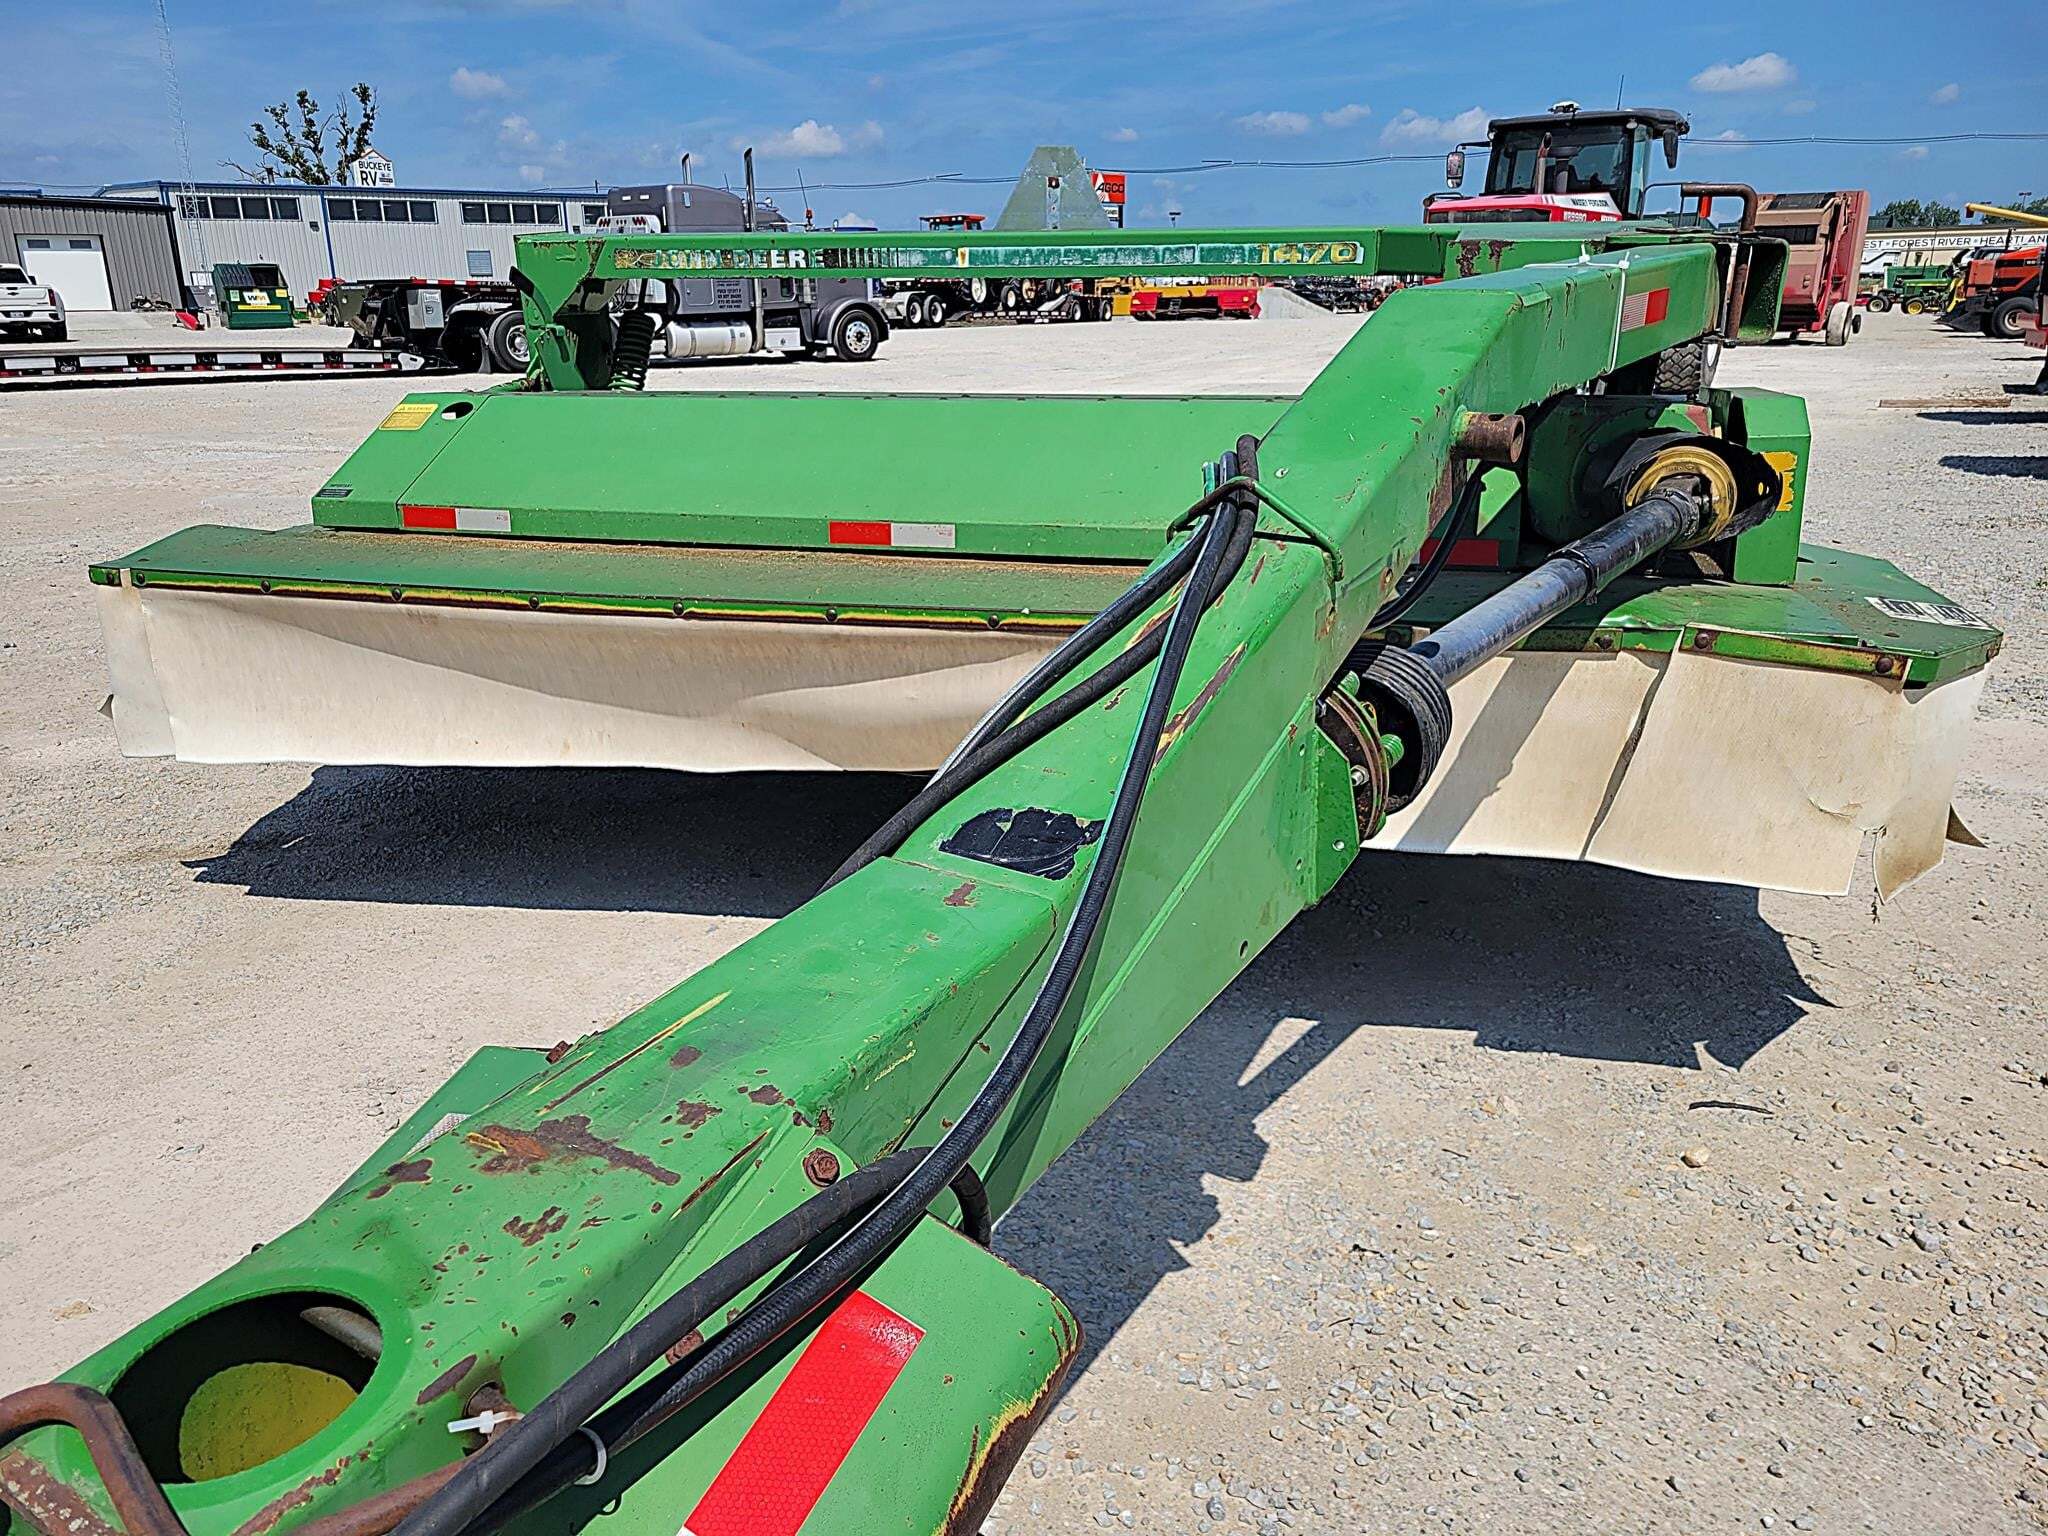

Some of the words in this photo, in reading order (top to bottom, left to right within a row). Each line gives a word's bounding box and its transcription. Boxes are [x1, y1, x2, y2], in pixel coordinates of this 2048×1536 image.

[358, 160, 392, 171] BUCKEYE
[360, 170, 377, 186] RV
[1096, 182, 1125, 193] AGCO
[1891, 238, 1935, 248] FOREST
[1938, 238, 1971, 246] RIVER
[1979, 235, 2046, 246] HEATLAN
[1257, 242, 1358, 264] 1470
